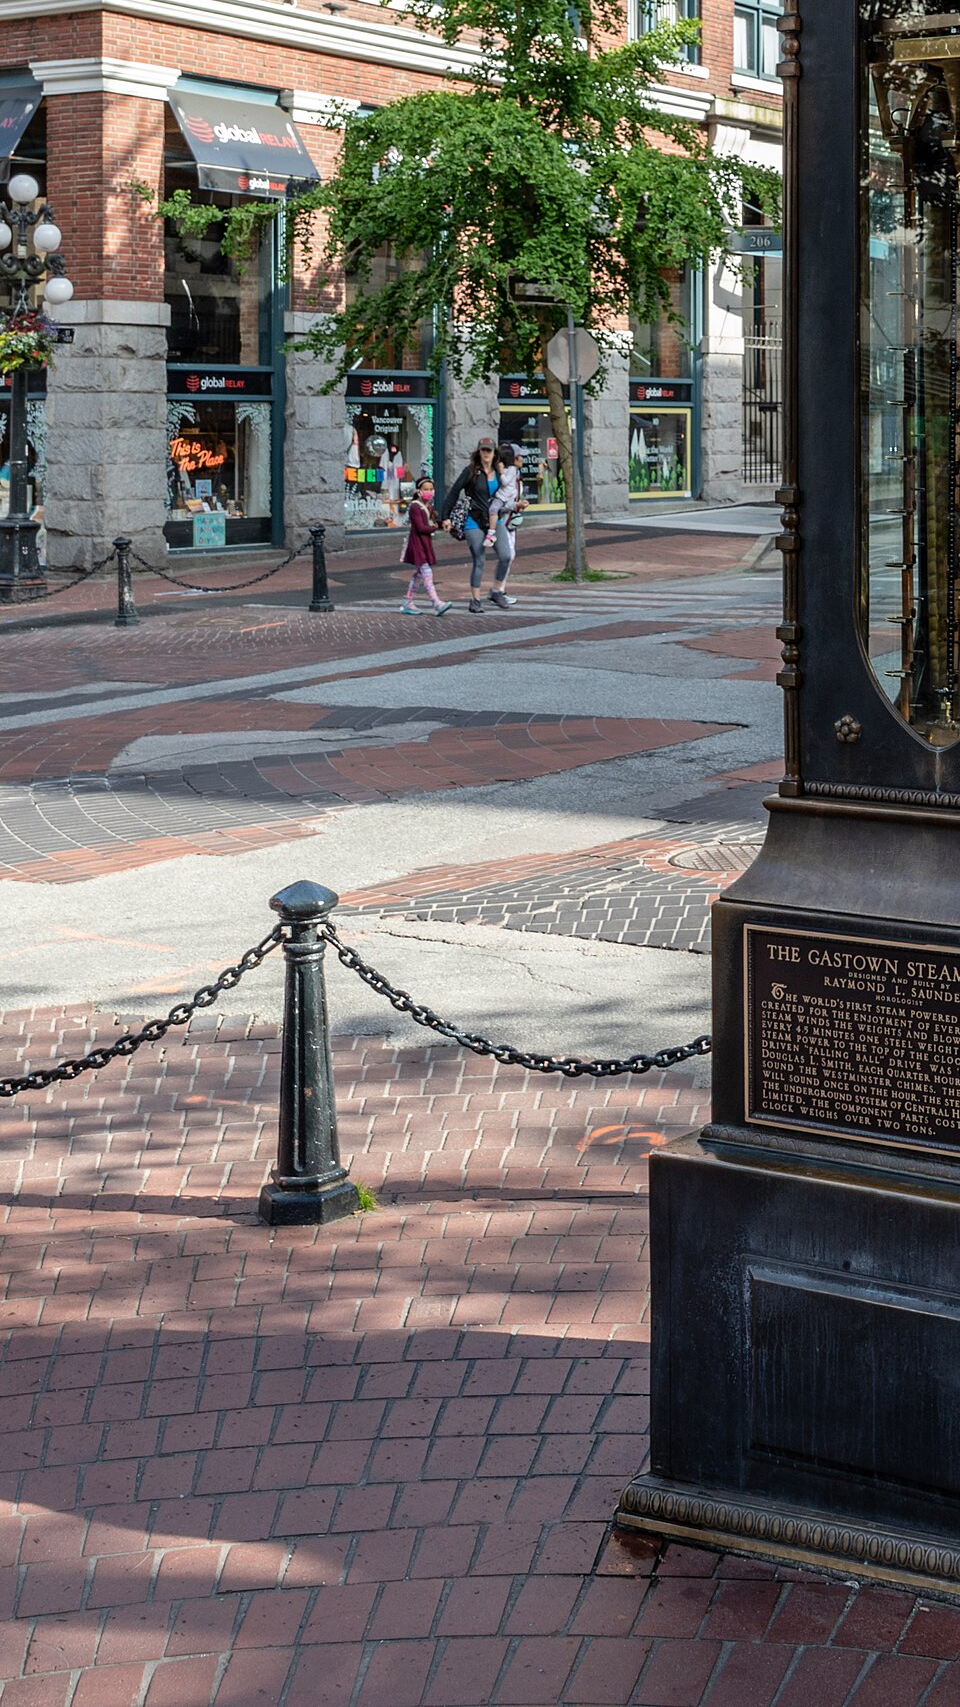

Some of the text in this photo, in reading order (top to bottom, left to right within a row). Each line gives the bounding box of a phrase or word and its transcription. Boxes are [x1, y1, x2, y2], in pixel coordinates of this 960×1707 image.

[750, 236, 771, 248] 206
[372, 416, 403, 424] Vancouver
[375, 425, 400, 434] Original
[170, 438, 201, 458] This is
[178, 450, 225, 471] the Place
[766, 944, 801, 963] THE
[808, 949, 899, 975] GASTOWN
[823, 976, 885, 993] RAYMOND
[895, 985, 905, 996] L.
[848, 971, 887, 982] DESIGNED
[891, 977, 908, 985] AND
[913, 979, 935, 988] BUILT
[761, 1000, 805, 1014] CREATED
[809, 1006, 829, 1017] FOR
[831, 1009, 851, 1020] THE
[853, 1013, 913, 1029] ENJOYMENT
[917, 1021, 930, 1031] OF
[802, 995, 844, 1009] WORLD'S
[846, 1001, 873, 1013] FIRST
[875, 1005, 906, 1017] STEAM
[910, 1009, 958, 1024] POWERED
[875, 994, 924, 1007] HOROLOGIST
[761, 1010, 792, 1022] STEAM
[797, 1014, 830, 1027] WINDS
[833, 1020, 853, 1030] THE
[857, 1023, 902, 1037] WEIGHTS
[906, 1030, 928, 1040] AND
[761, 1020, 792, 1032] EVERY
[812, 1027, 855, 1041] MINUTES
[859, 1034, 880, 1044] ONE
[884, 1037, 913, 1049] STEEL
[917, 1041, 959, 1055] WEIGHT
[761, 1029, 792, 1042] STEAM
[796, 1034, 830, 1047] POWER
[833, 1039, 846, 1049] TO
[848, 1042, 867, 1052] THE
[871, 1045, 890, 1056] TOP
[893, 1048, 905, 1058] OF
[909, 1050, 929, 1062] THE
[761, 1039, 800, 1052] DRIVEN
[889, 1058, 922, 1071] DRIVE
[929, 1064, 952, 1075] WAS
[761, 1048, 805, 1064] DOUGLAS
[810, 1055, 819, 1066] L.
[821, 1057, 855, 1071] SMITH.
[858, 1064, 884, 1076] EACH
[886, 1068, 931, 1082] QUARTER
[762, 1060, 794, 1072] SOUND
[799, 1065, 817, 1076] THE
[822, 1069, 892, 1087] WESTMINSTER
[896, 1080, 937, 1094] CHIMES.
[762, 1069, 785, 1081] WILL
[789, 1074, 820, 1086] SOUND
[823, 1080, 850, 1091] ONCE
[853, 1084, 867, 1094] ON
[870, 1086, 888, 1097] THE
[891, 1090, 921, 1102] HOUR.
[922, 1094, 942, 1105] THE
[762, 1080, 780, 1091] THE
[784, 1084, 853, 1102] UNDERGROUND
[854, 1095, 888, 1108] SYSTEM
[890, 1100, 902, 1110] OF
[904, 1101, 950, 1117] CENTRAL
[762, 1089, 806, 1105] LIMITED.
[811, 1098, 830, 1109] THE
[834, 1101, 893, 1118] COMPONENT
[900, 1112, 929, 1124] PARTS
[762, 1101, 936, 1135] CLOCK WEIGHS OVER TWO TONS.
